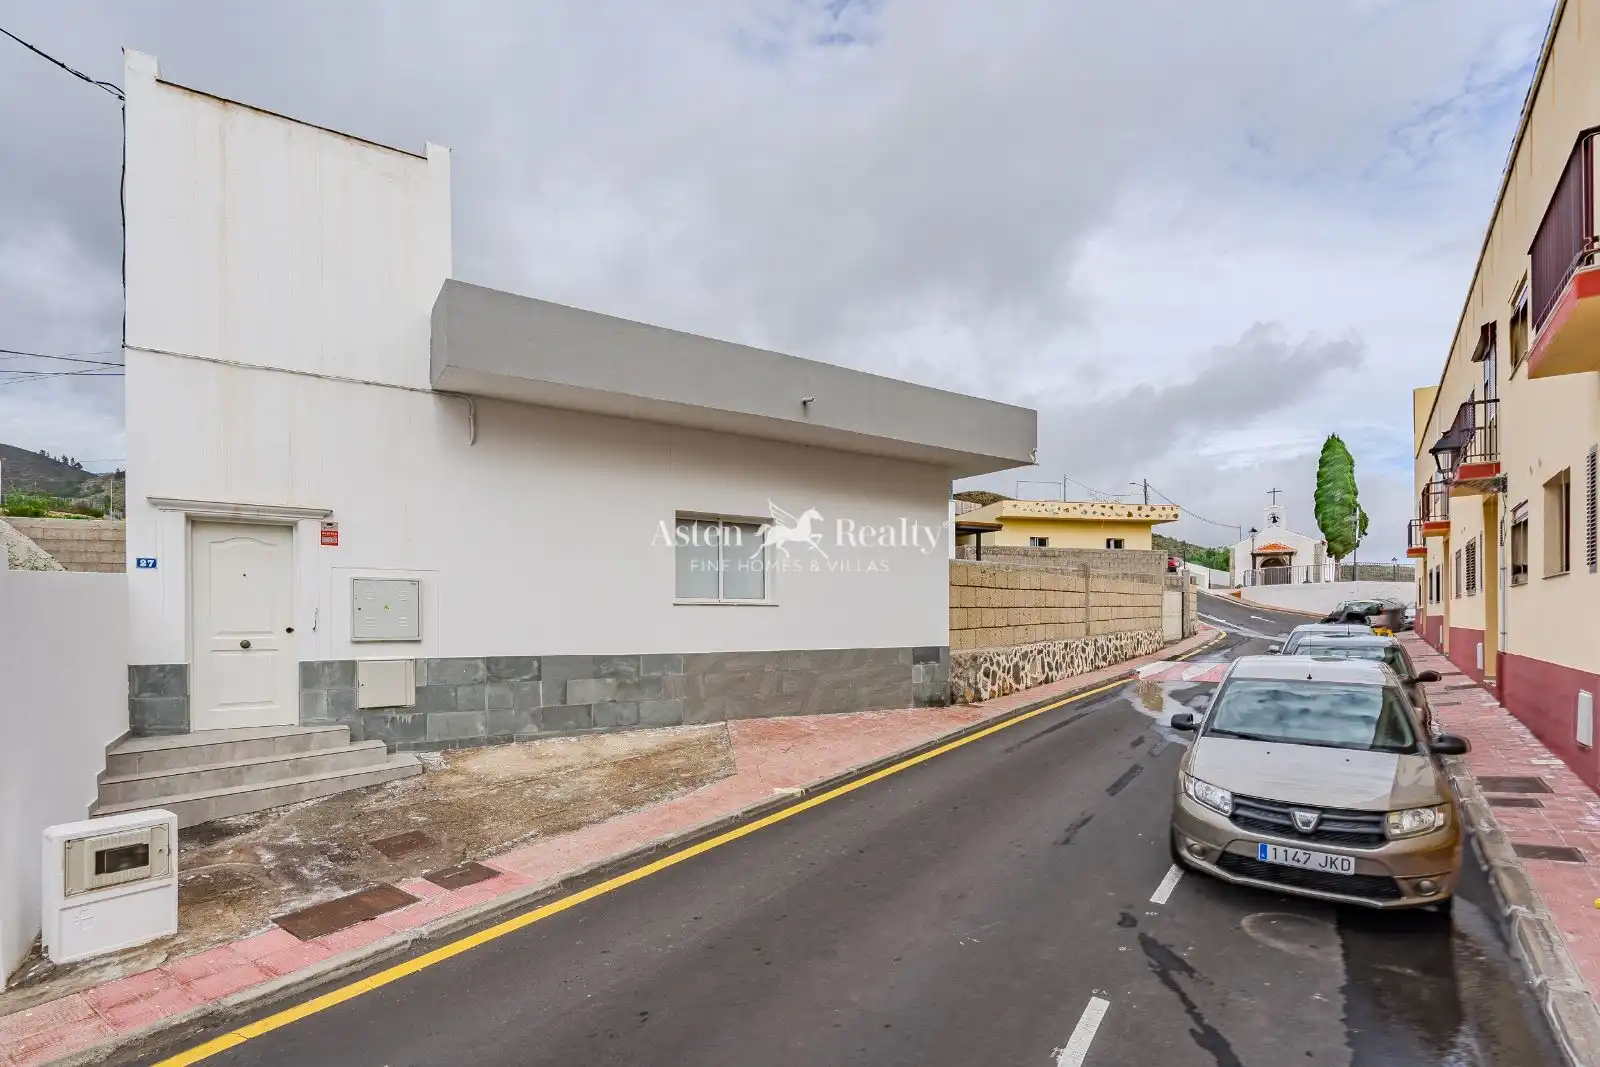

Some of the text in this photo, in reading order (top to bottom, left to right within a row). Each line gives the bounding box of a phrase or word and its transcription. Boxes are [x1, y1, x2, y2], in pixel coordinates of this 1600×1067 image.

[139, 559, 155, 568] 27
[1272, 847, 1351, 872] 1147 JKD
